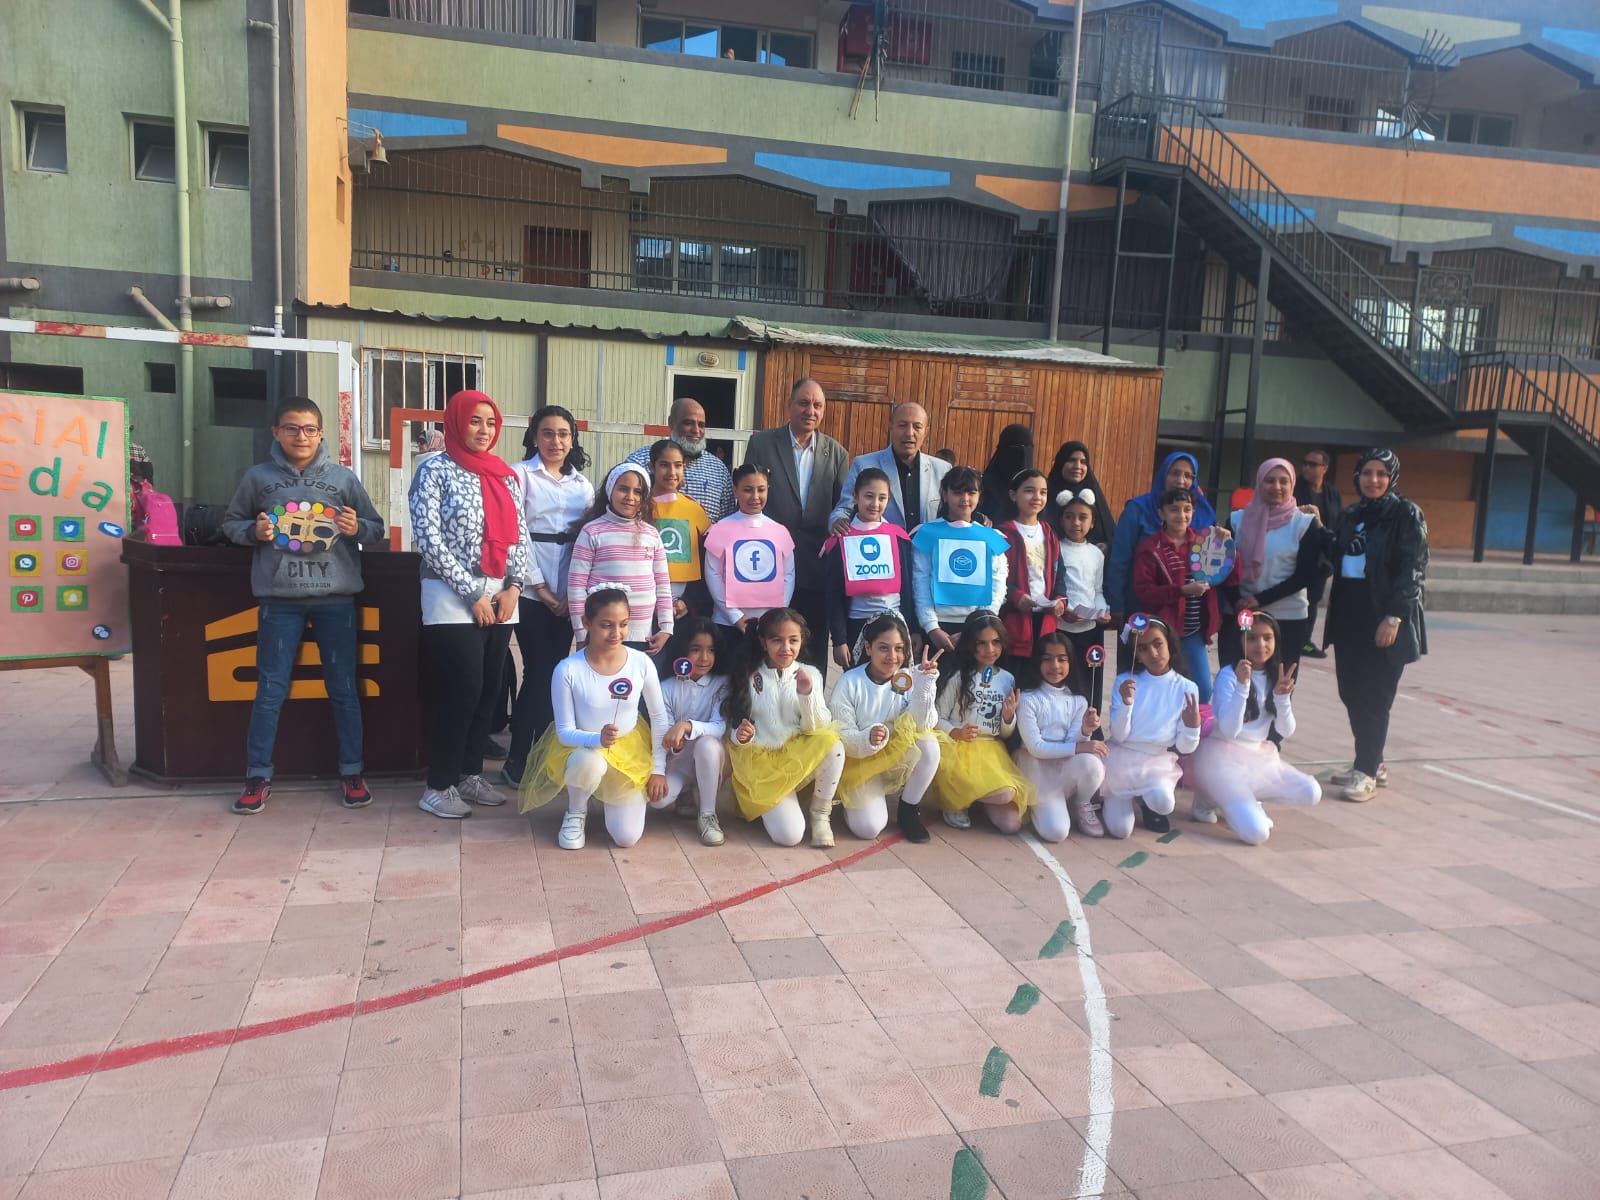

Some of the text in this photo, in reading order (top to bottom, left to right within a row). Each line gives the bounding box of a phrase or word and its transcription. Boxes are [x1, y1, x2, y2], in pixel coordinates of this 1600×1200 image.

[260, 479, 299, 496] EAM
[287, 560, 329, 578] CITY
[855, 563, 890, 575] zoom
[613, 682, 629, 696] G
